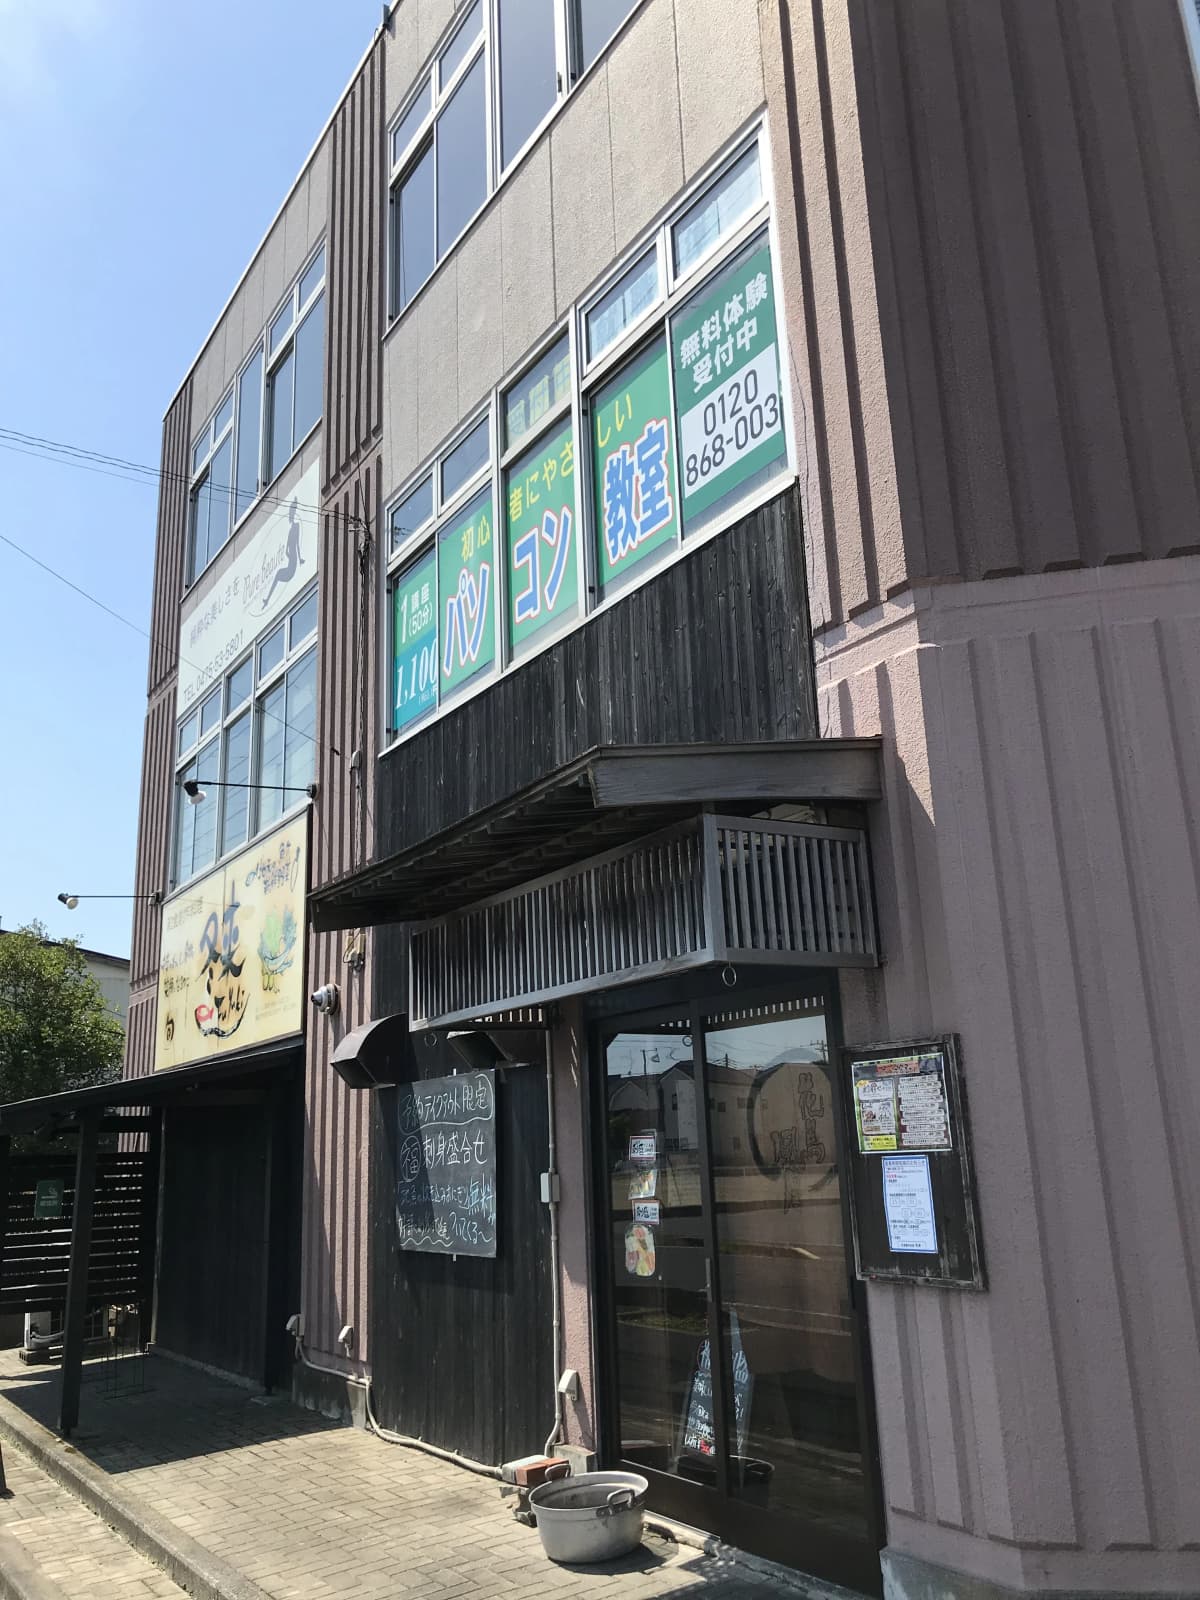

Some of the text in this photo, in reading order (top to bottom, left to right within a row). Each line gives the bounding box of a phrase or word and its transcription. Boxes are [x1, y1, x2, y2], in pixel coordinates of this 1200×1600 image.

[681, 272, 768, 369] 無料体験
[693, 316, 757, 393] 受付中
[685, 393, 778, 487] 868-003
[703, 369, 758, 436] 0120
[423, 1129, 488, 1169] 刺身盛合せ
